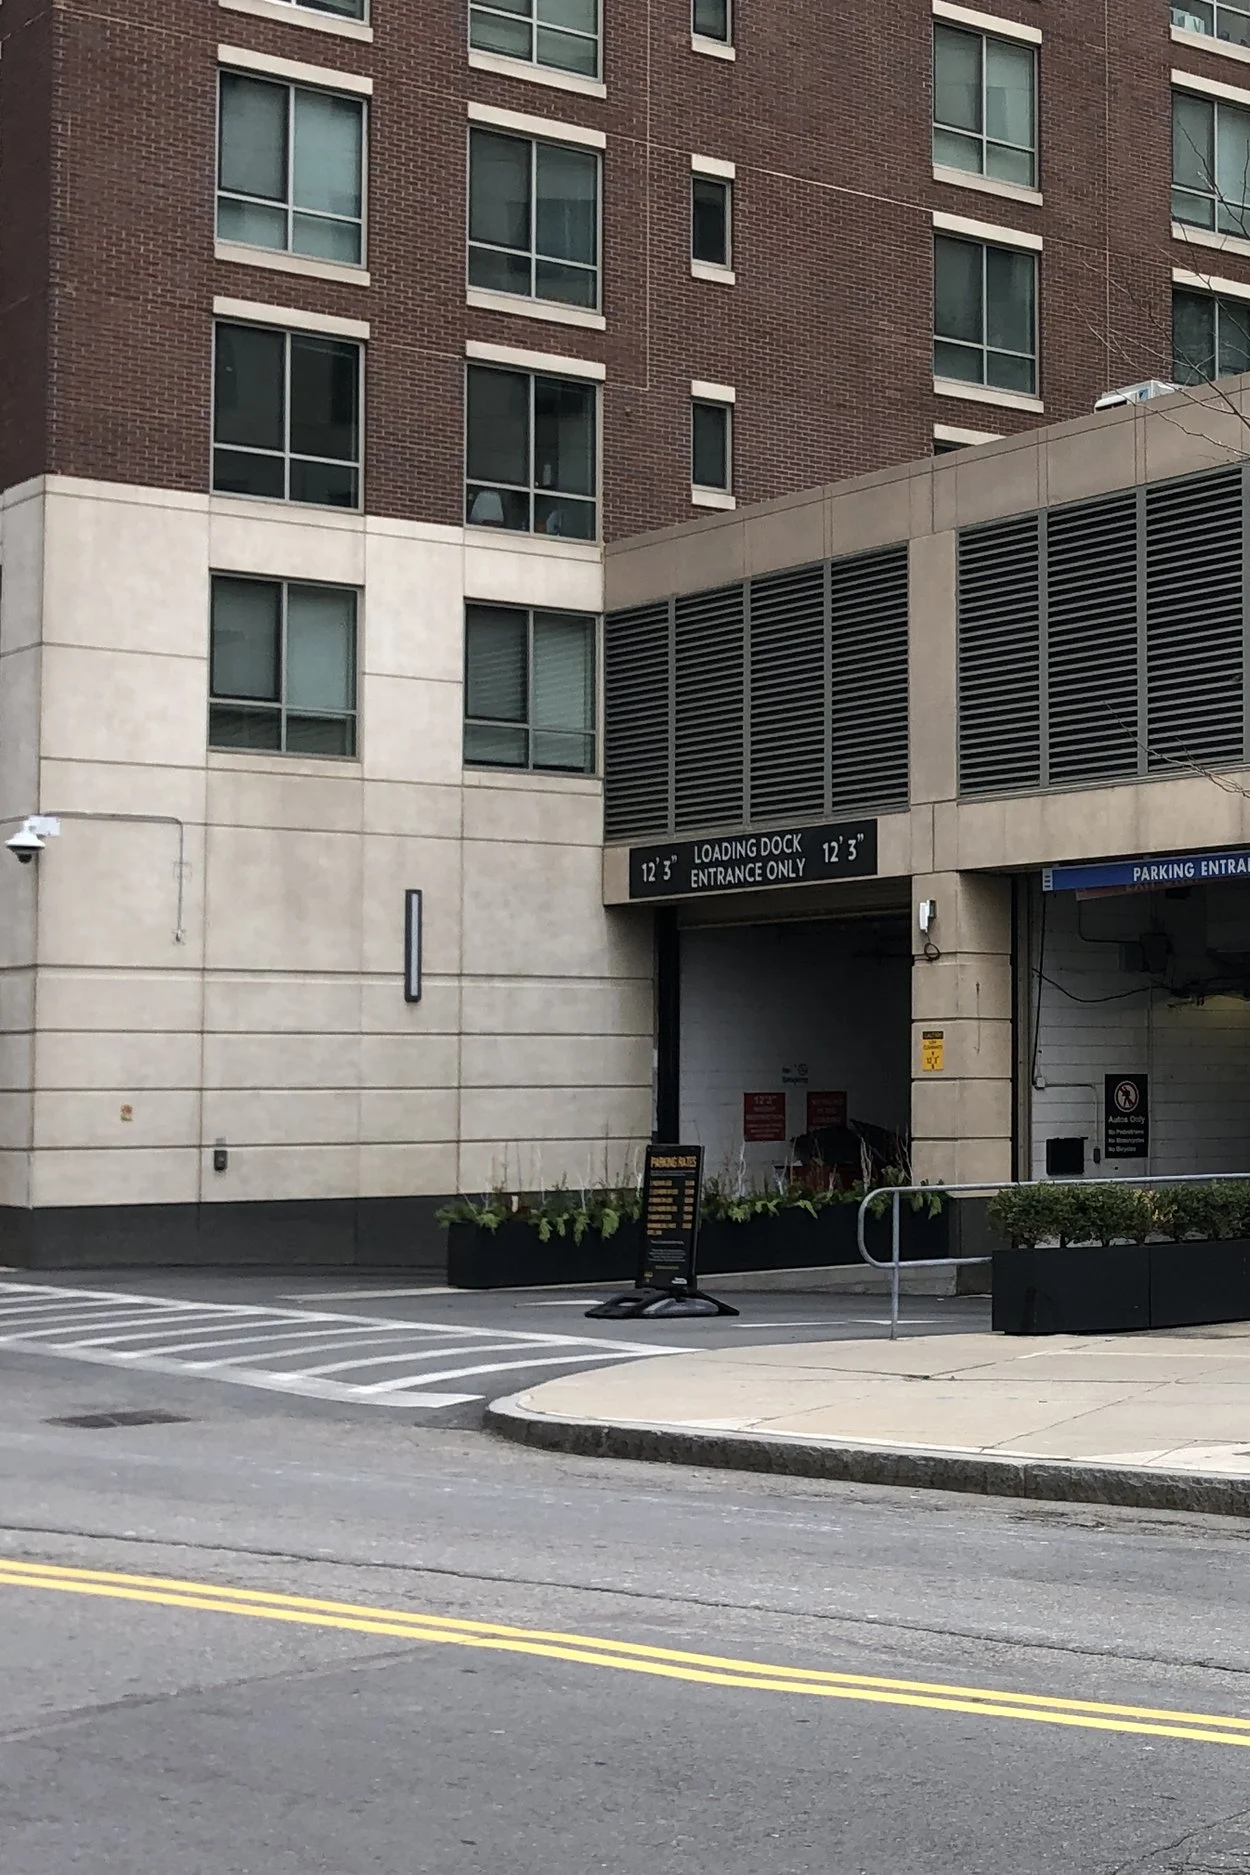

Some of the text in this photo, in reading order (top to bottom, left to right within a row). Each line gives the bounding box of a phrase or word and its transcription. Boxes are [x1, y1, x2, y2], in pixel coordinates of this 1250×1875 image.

[694, 833, 802, 864] LOADING DOCK
[691, 858, 806, 888] ENTRANCE ONLY
[1133, 862, 1195, 882] PARKING
[1108, 1115, 1145, 1125] Autos Only
